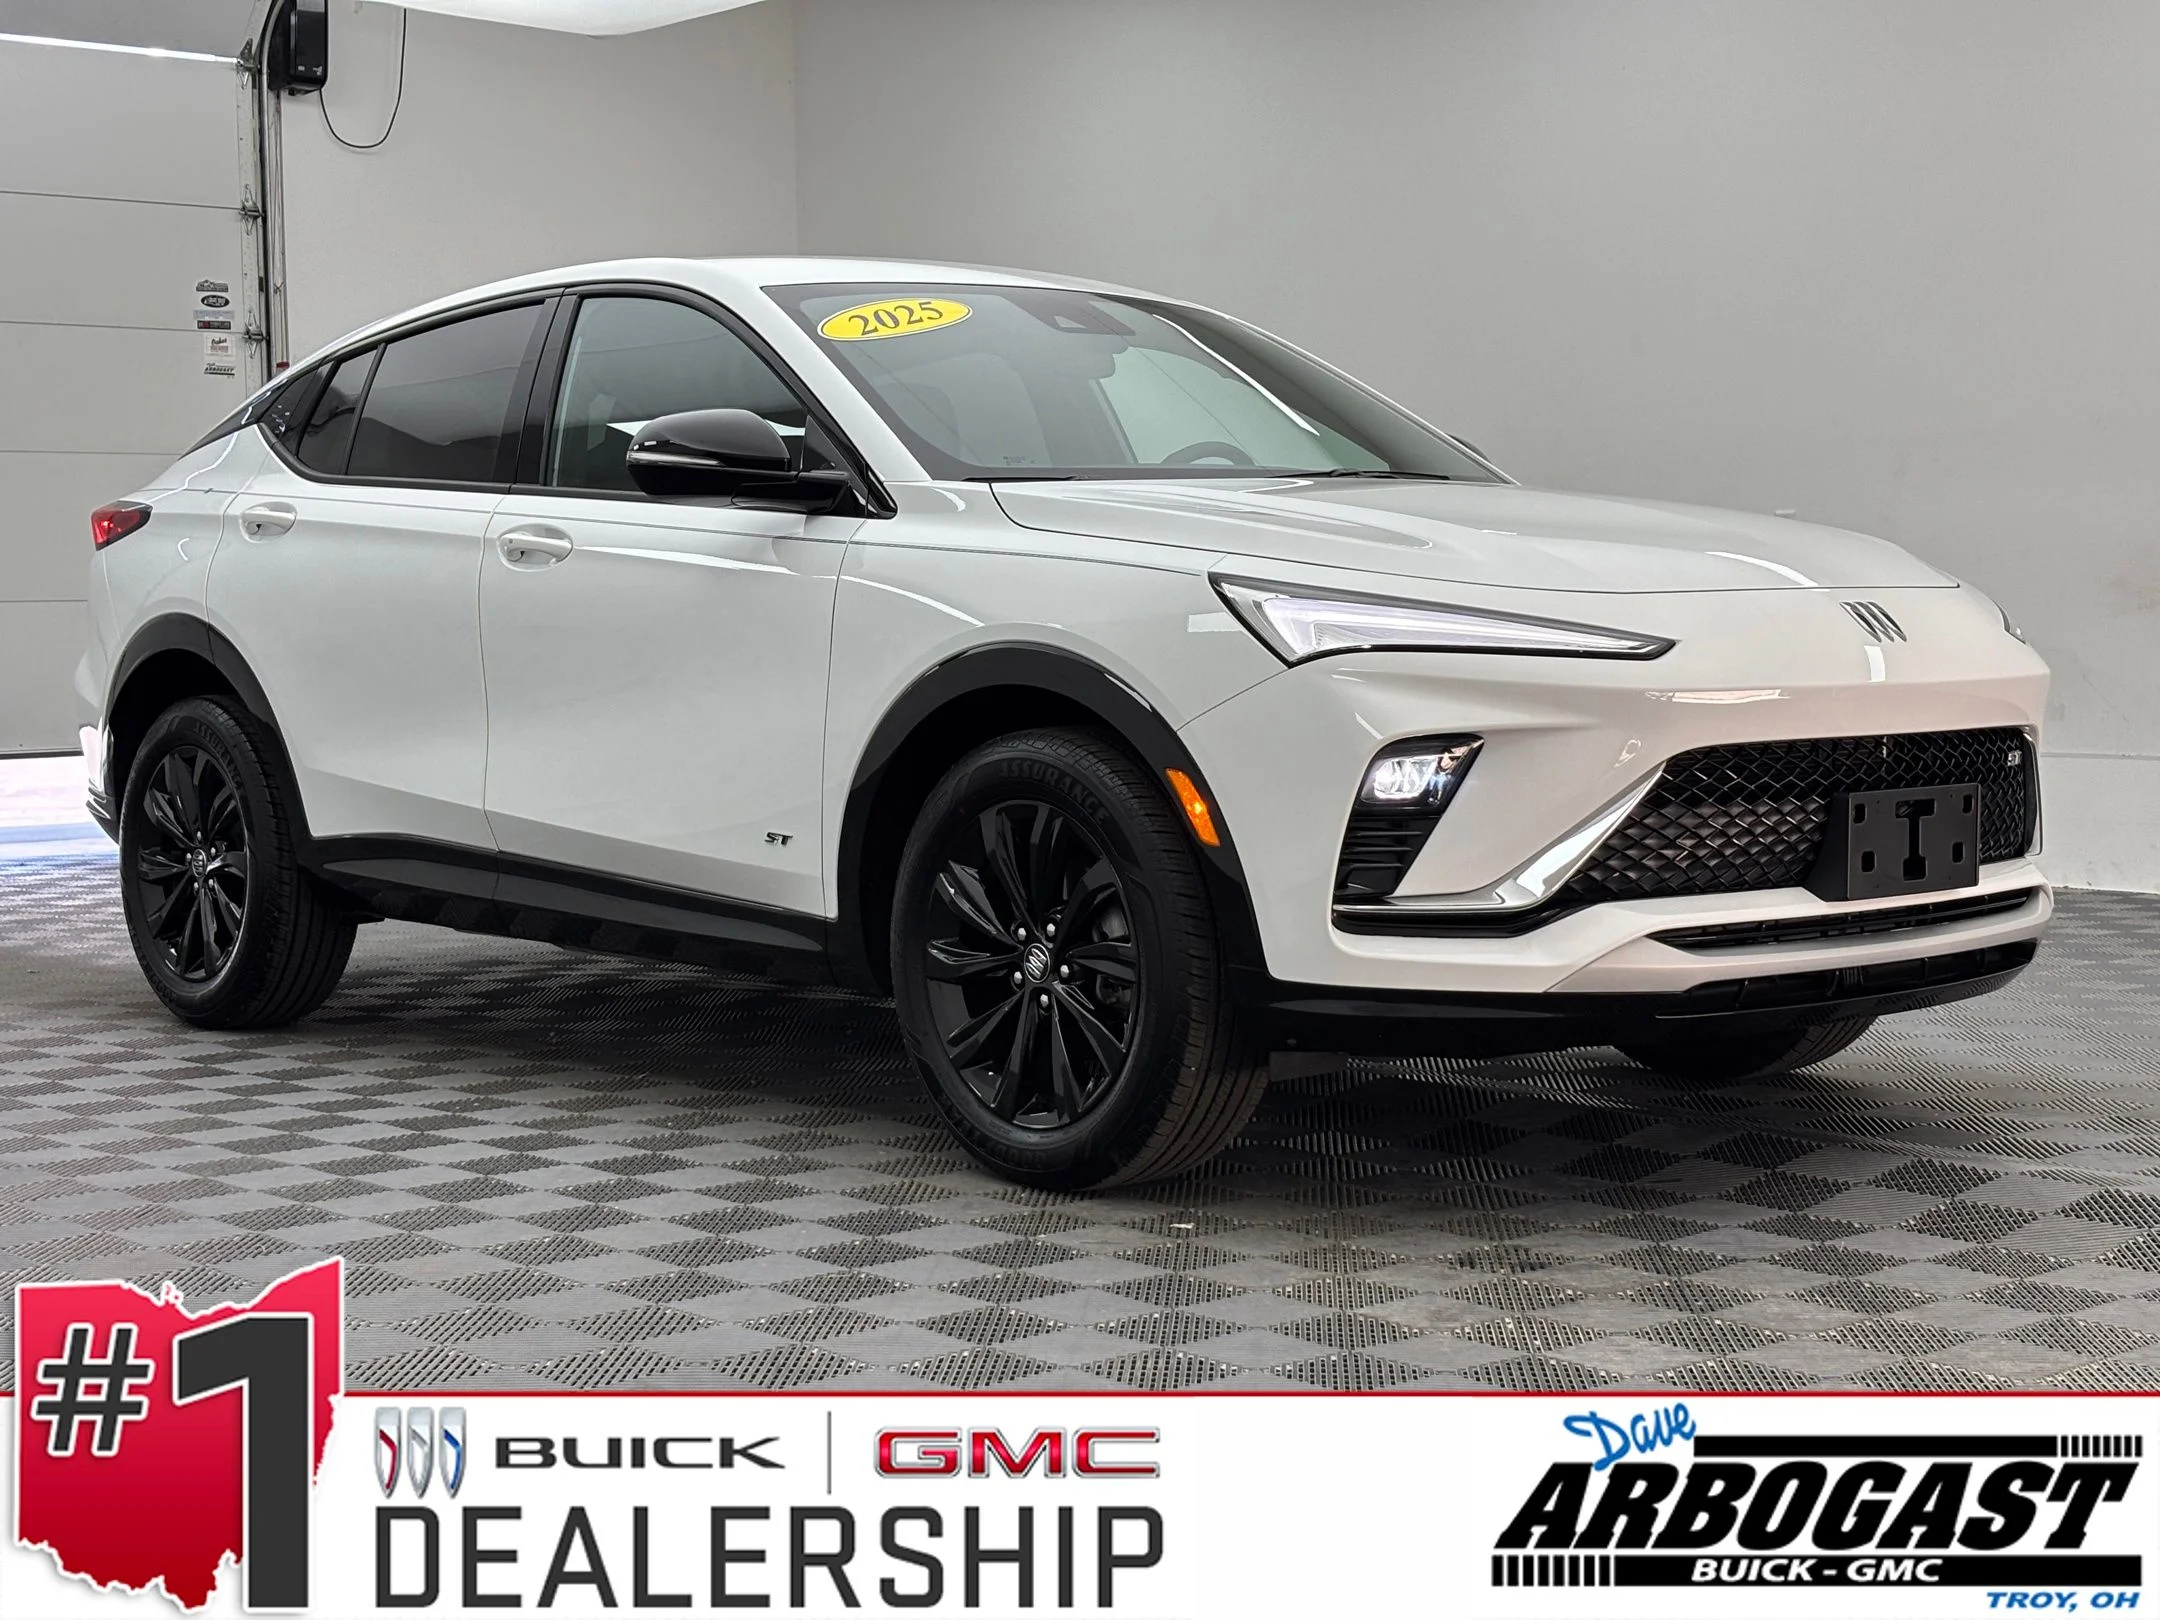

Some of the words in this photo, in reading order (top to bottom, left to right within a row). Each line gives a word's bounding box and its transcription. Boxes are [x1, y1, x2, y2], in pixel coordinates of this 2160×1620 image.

[848, 301, 944, 336] 2025
[998, 758, 1109, 825] ASSURANCE
[764, 831, 794, 847] ST
